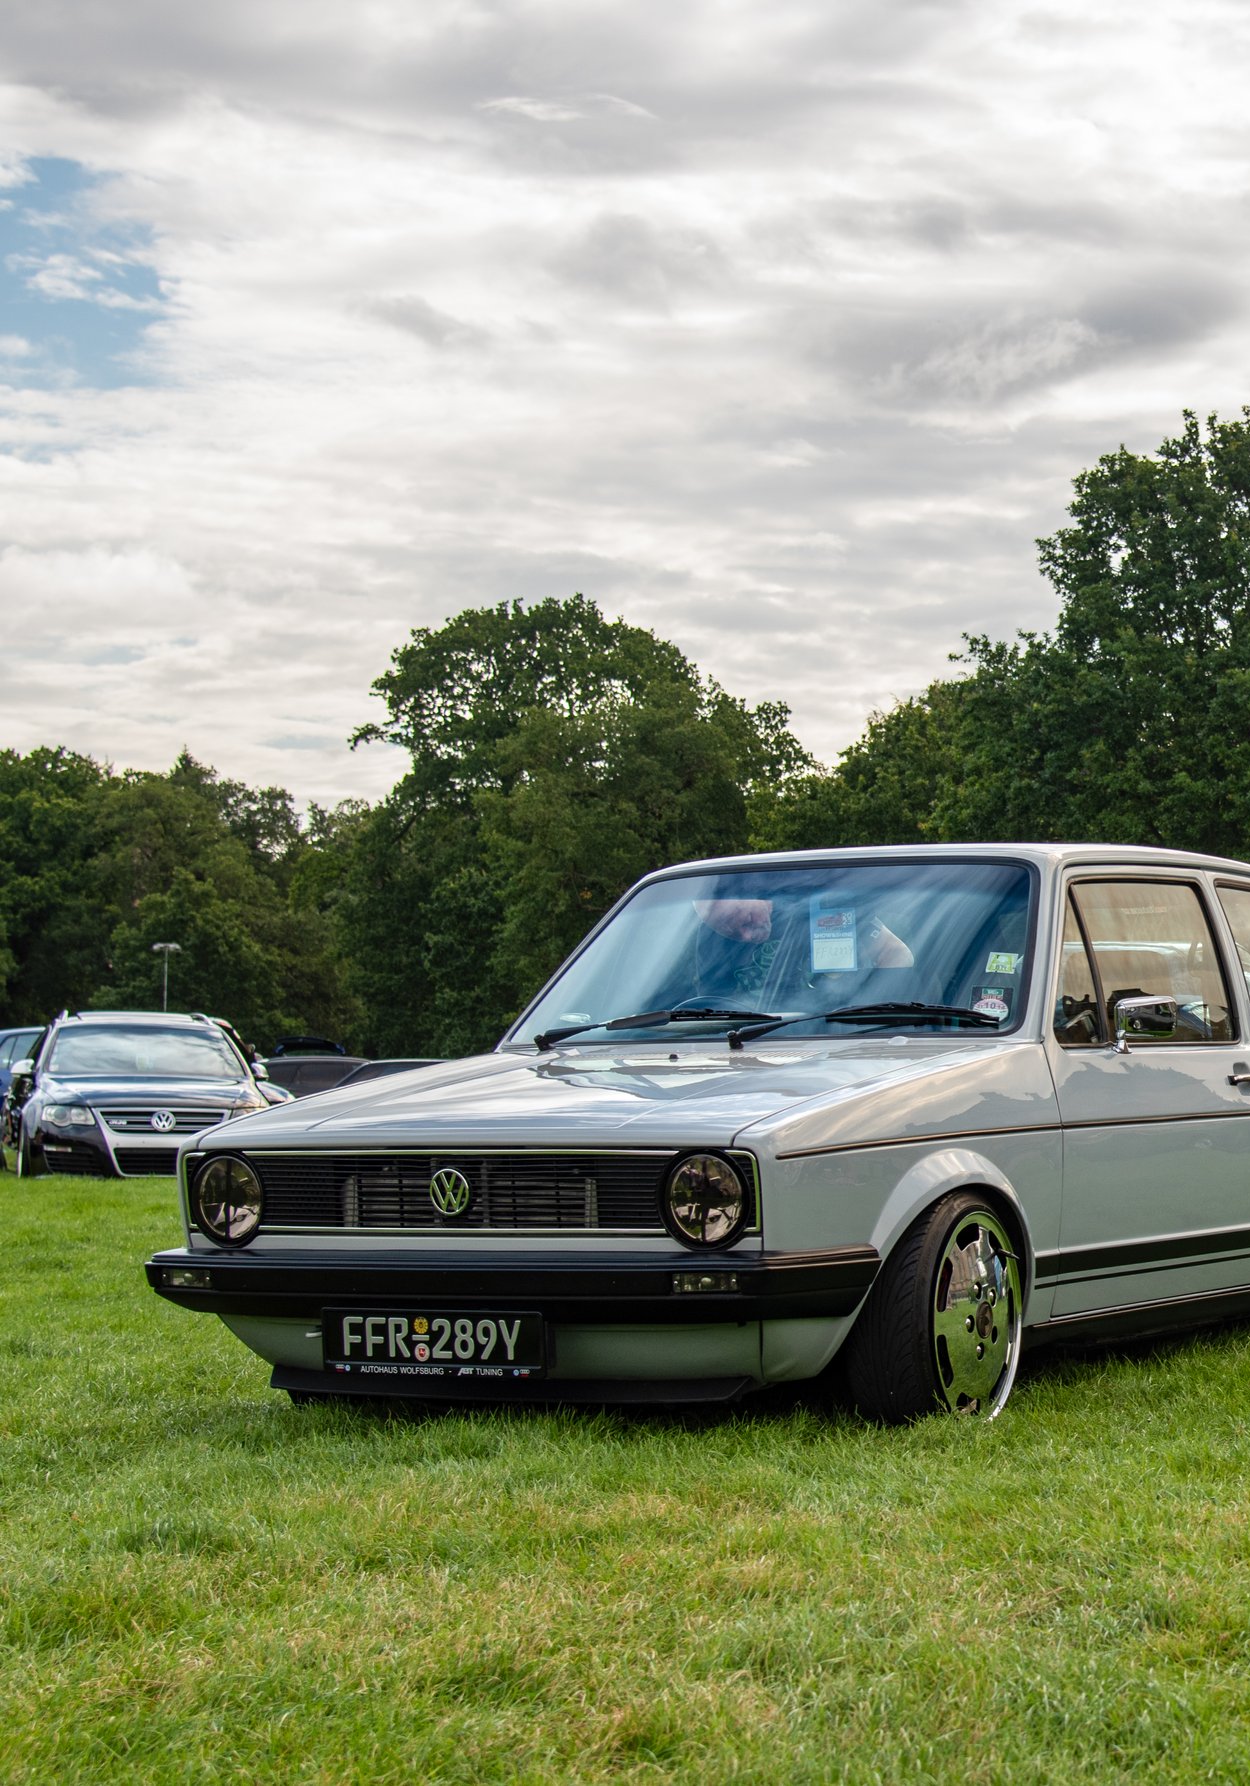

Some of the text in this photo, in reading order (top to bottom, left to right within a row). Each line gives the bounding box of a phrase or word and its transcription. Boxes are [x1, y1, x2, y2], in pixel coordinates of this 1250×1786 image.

[430, 1168, 469, 1215] VW
[360, 1365, 398, 1374] AUTOHAUS
[400, 1367, 444, 1375] WOLFSBURG
[457, 1367, 474, 1376] ABT
[475, 1368, 503, 1376] TUNING
